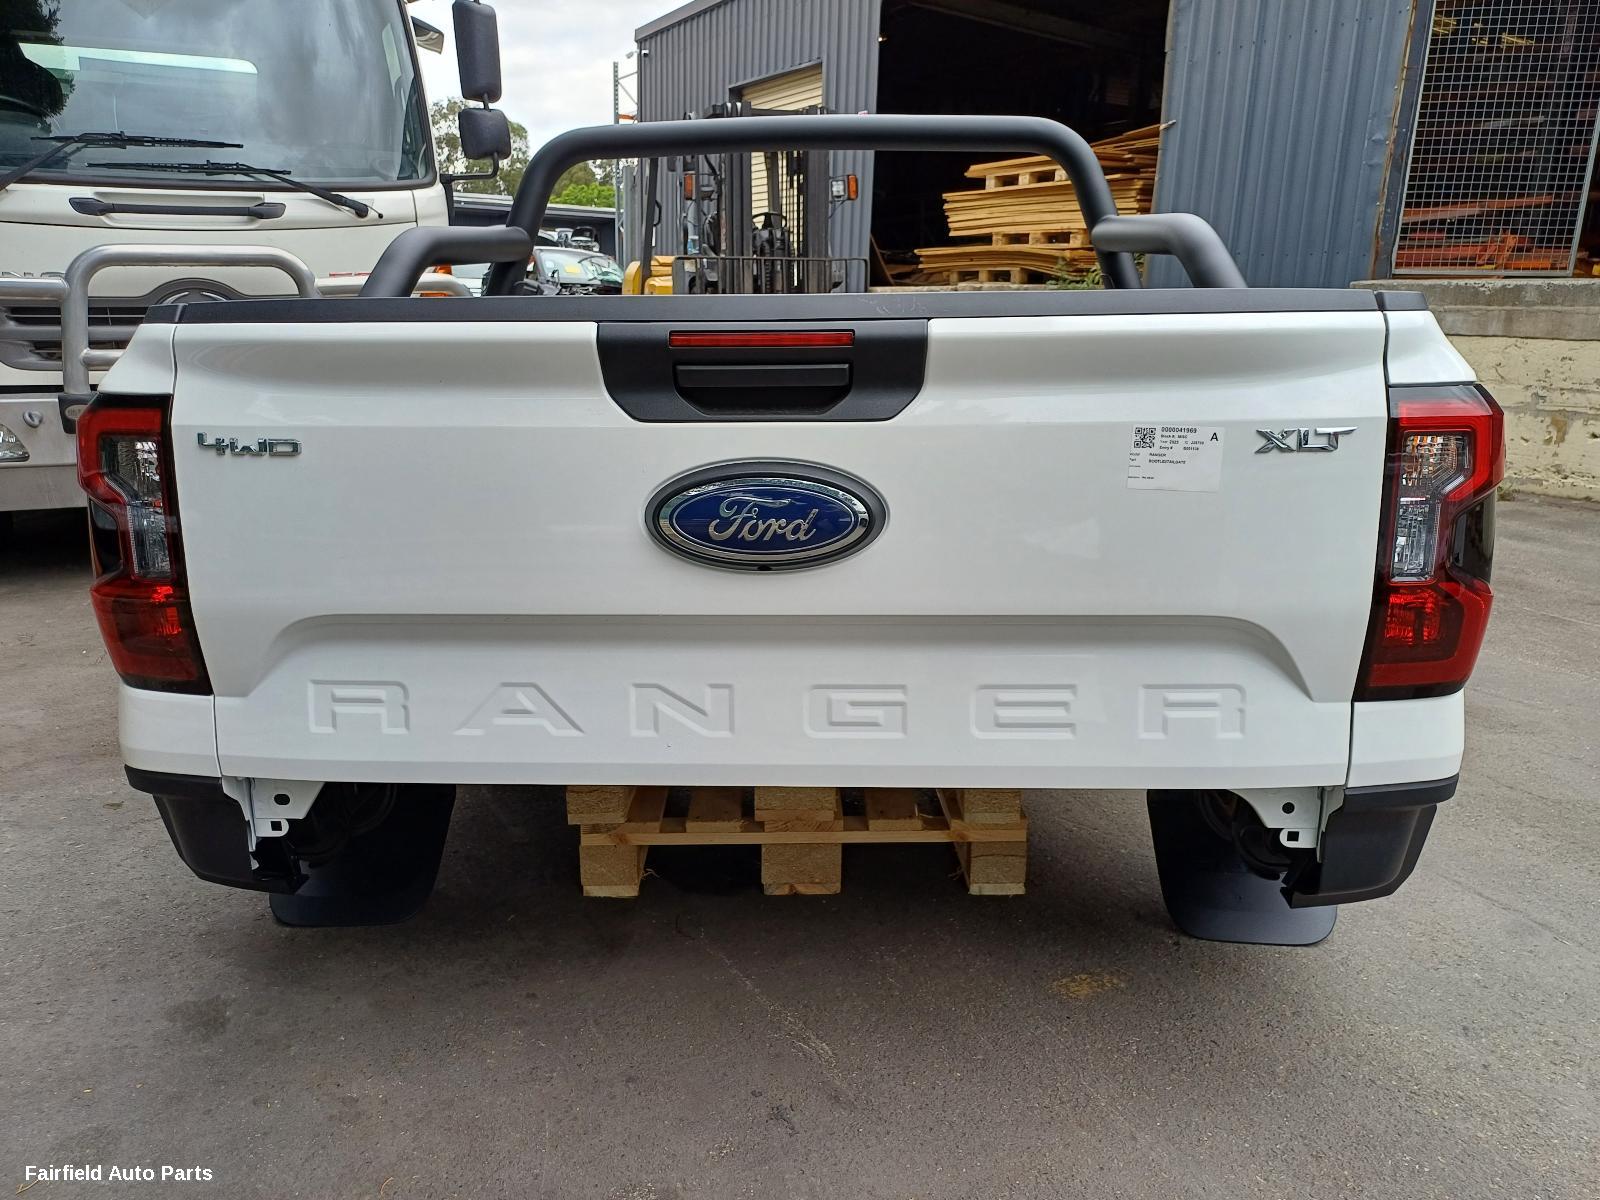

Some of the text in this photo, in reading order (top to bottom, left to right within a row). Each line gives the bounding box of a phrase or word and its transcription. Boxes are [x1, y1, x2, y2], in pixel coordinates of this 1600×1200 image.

[197, 432, 302, 456] 4WD
[1210, 432, 1219, 442] A
[1254, 426, 1358, 454] XLT
[708, 496, 819, 541] Ford
[308, 680, 1247, 740] RANGER
